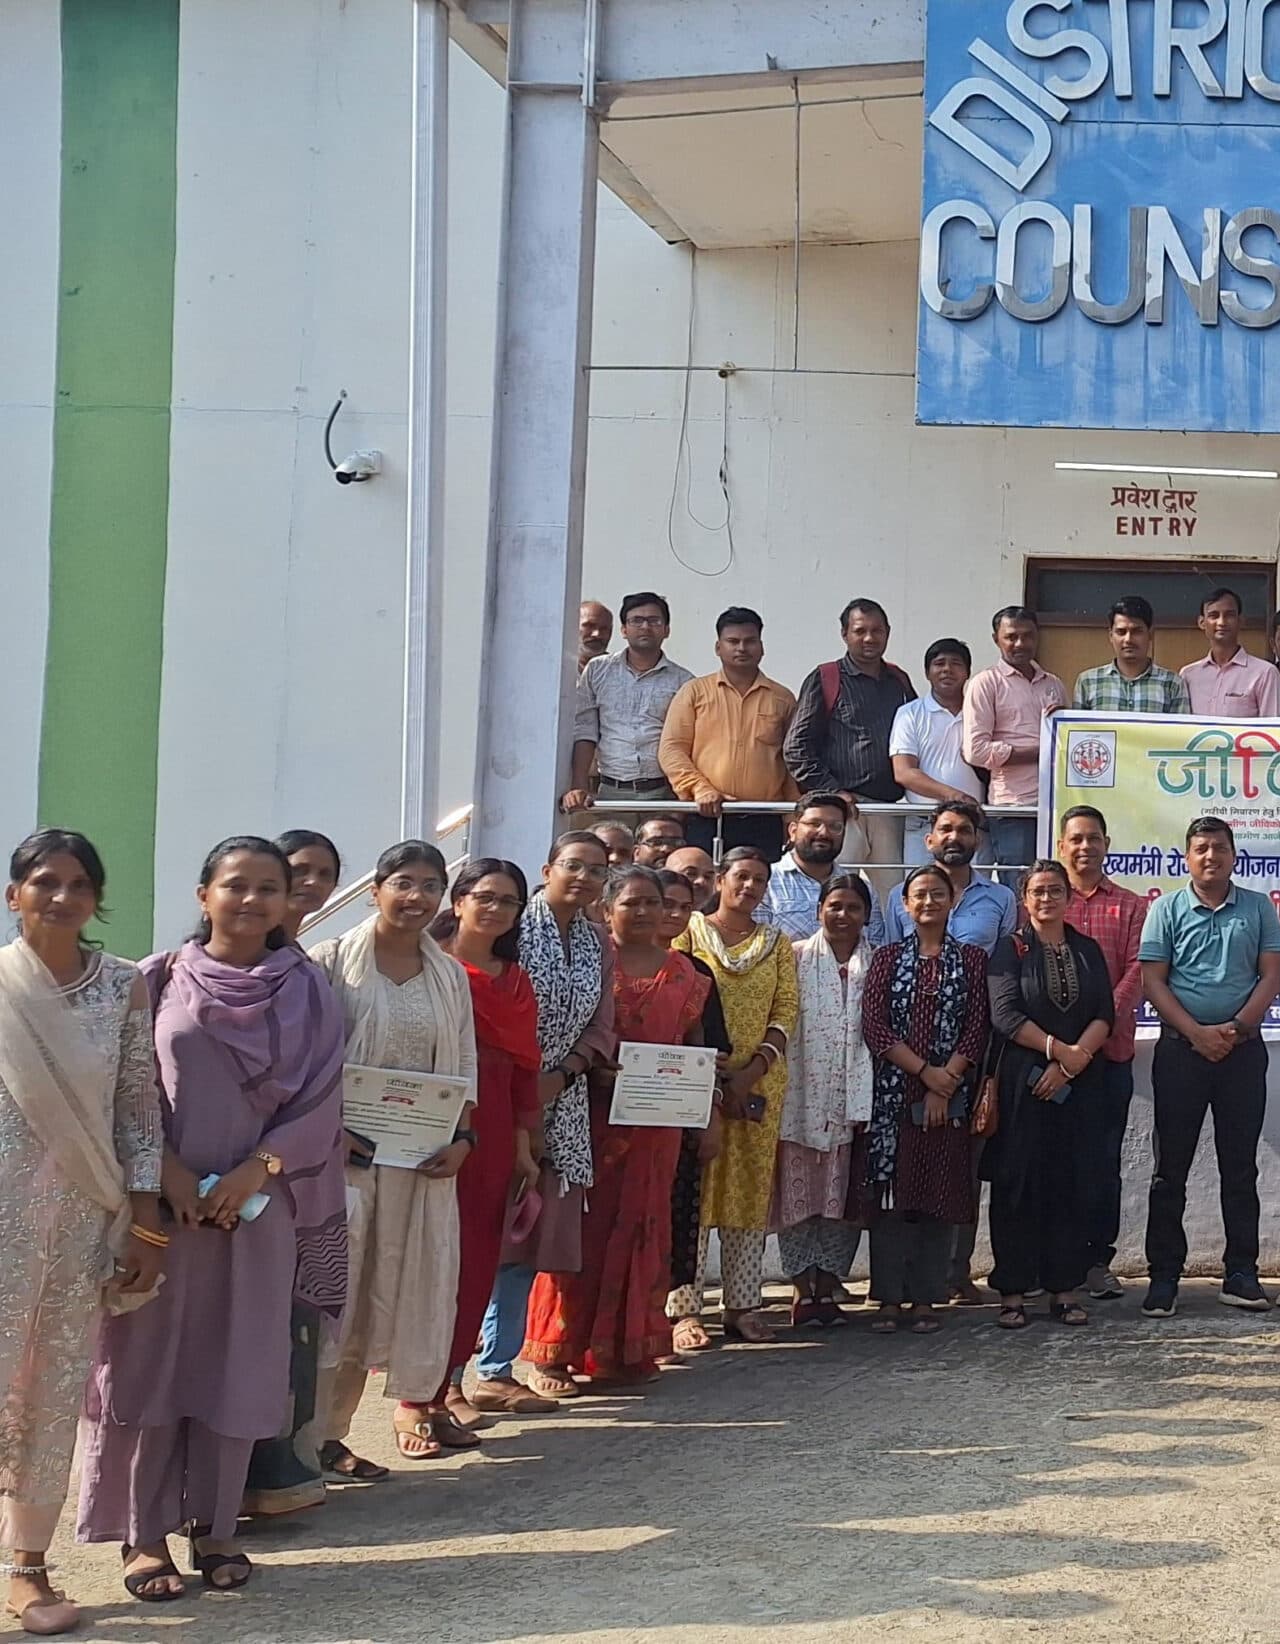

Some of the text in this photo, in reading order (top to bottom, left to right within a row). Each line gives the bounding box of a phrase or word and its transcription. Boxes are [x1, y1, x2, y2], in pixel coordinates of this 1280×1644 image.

[1110, 481, 1199, 514] प्रवेश द्वार
[1116, 516, 1198, 537] ENTRY
[1102, 845, 1163, 877] ख्यमंत्री
